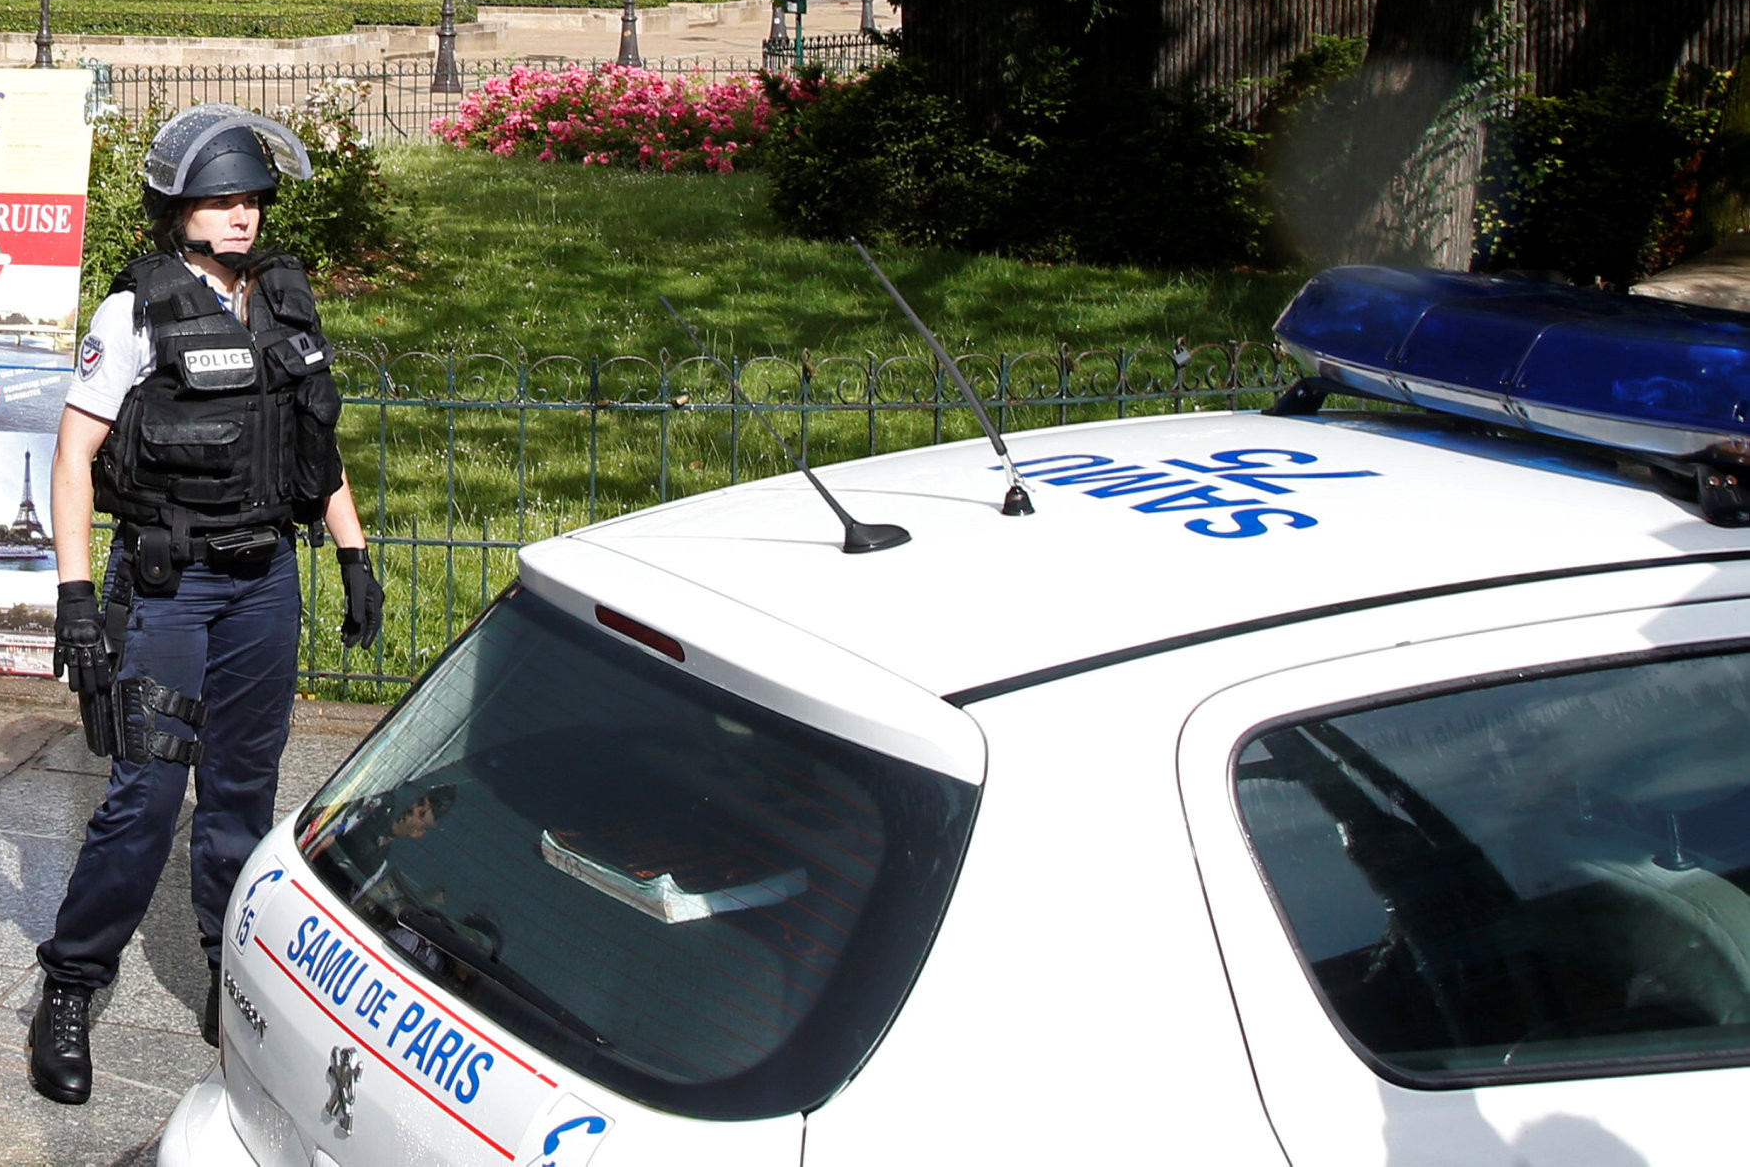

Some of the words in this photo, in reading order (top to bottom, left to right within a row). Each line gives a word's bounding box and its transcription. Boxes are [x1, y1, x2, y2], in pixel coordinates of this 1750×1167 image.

[187, 352, 252, 369] POLICE
[1159, 448, 1384, 495] 75
[987, 454, 1319, 539] SAMU
[236, 905, 255, 946] 15
[287, 916, 368, 1006] SAMU
[355, 978, 397, 1030] DE
[387, 1001, 494, 1105] PARIS
